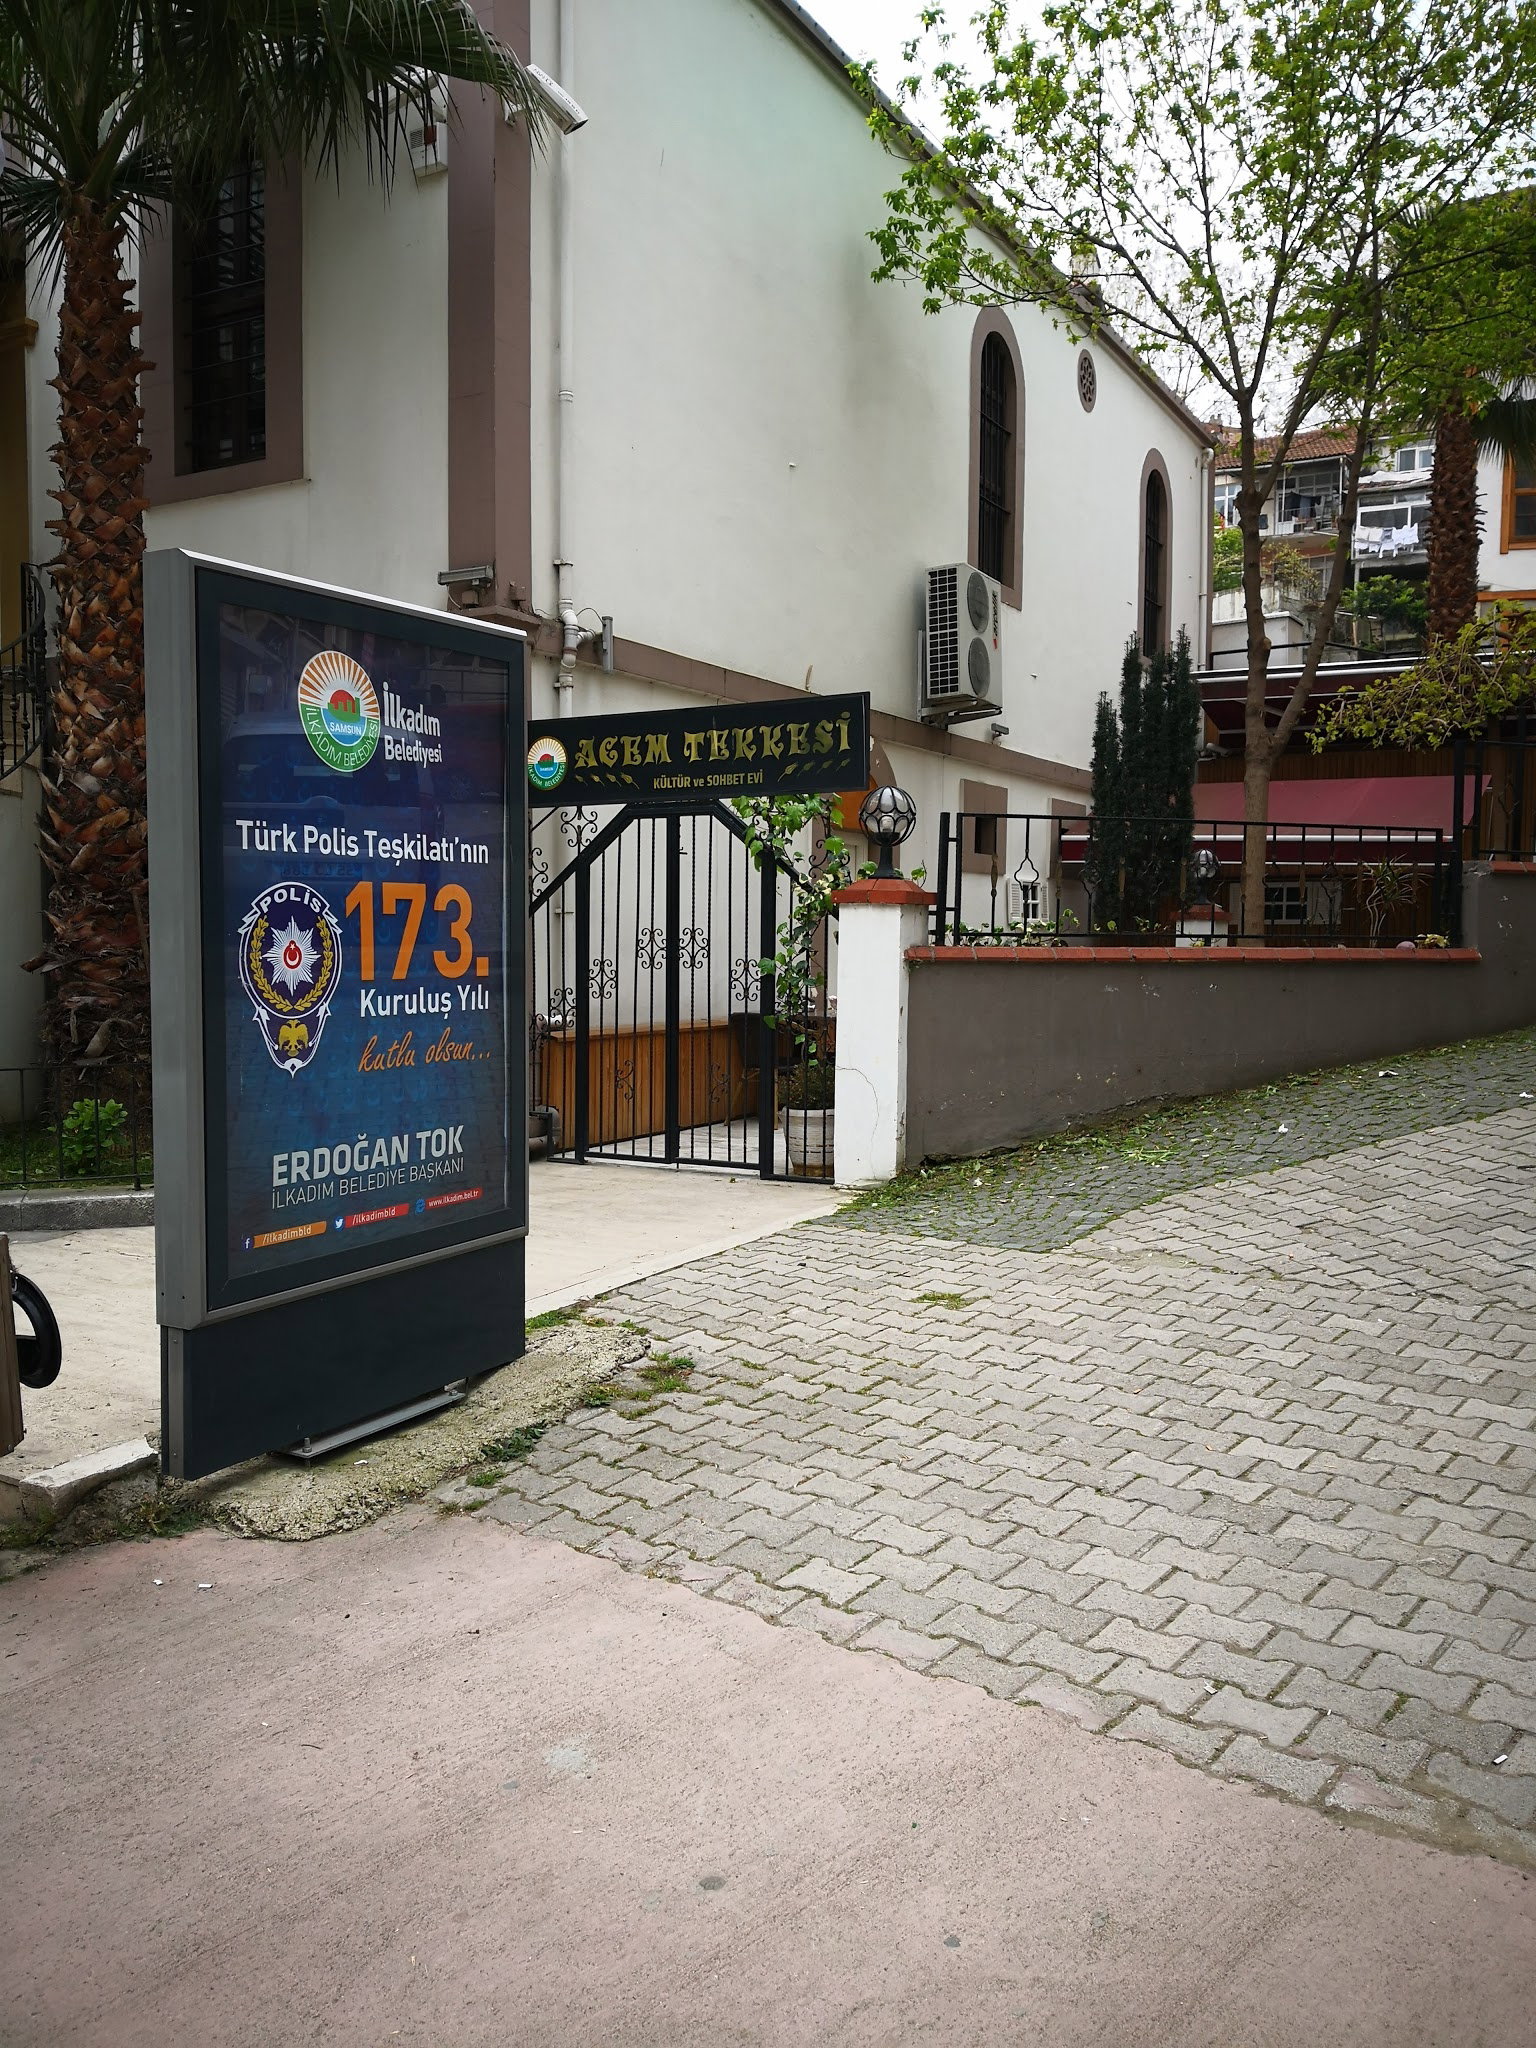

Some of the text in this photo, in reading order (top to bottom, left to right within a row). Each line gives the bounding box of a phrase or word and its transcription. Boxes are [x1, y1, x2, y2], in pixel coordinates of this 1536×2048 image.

[329, 721, 363, 736] SAMSUN
[382, 681, 441, 737] İlkadım
[306, 706, 378, 767] İLKADIM BELEDİYESİ
[384, 734, 443, 769] Belediyesi
[575, 711, 851, 769] ACEM TEKKESİ
[653, 770, 763, 790] KÜLTÜR ve SOHBET EVİ
[235, 819, 298, 853] Türk
[303, 825, 359, 857] Polis
[260, 887, 322, 914] POLİS
[345, 881, 489, 981] 173.
[360, 984, 489, 1020] Kuruluş Yılı
[358, 1030, 416, 1073] kutlu
[272, 1124, 465, 1187] ERDOĞAN TOK
[271, 1157, 465, 1210] İLKADIM BELEDİYE BAŞKANI
